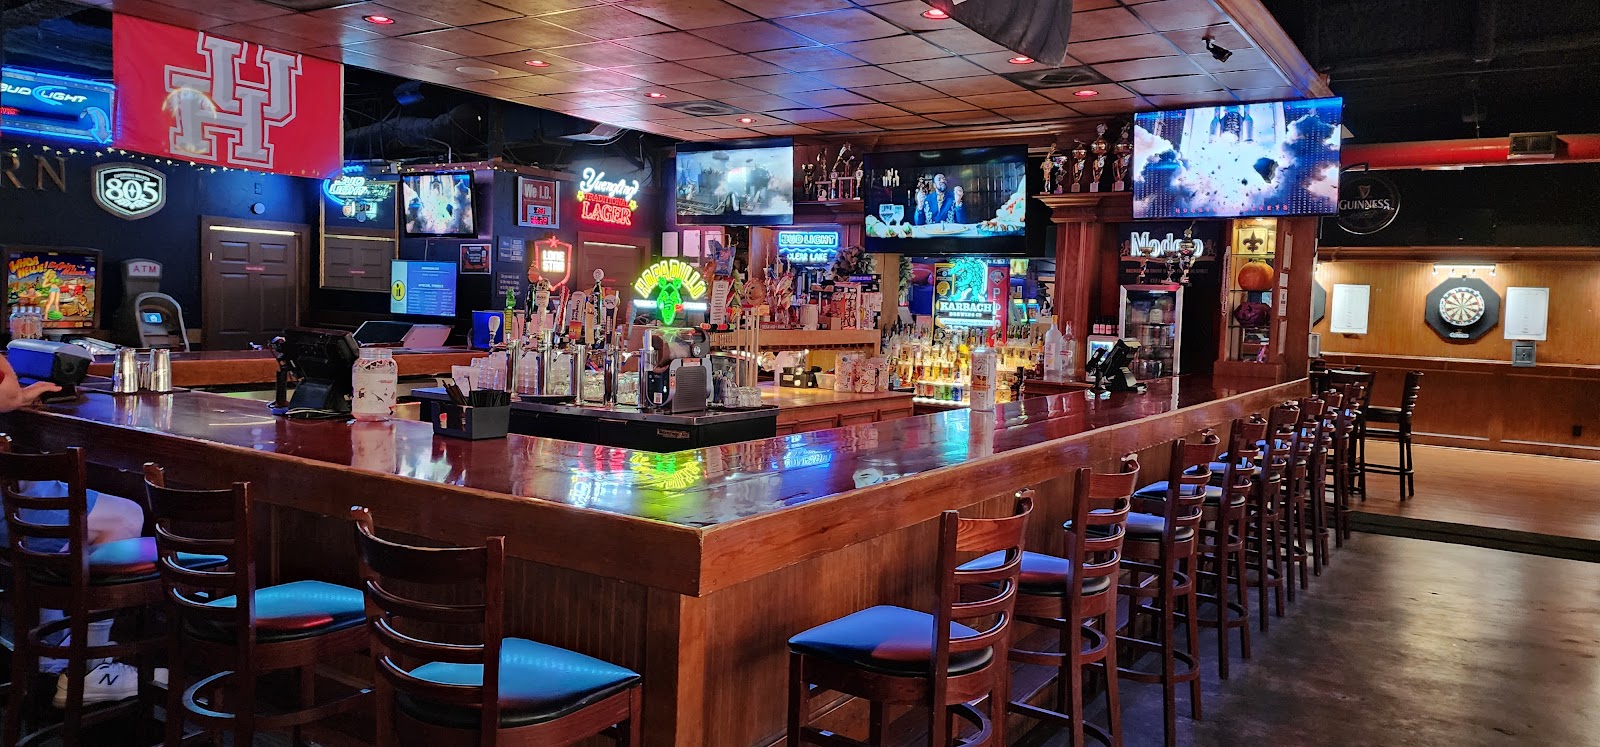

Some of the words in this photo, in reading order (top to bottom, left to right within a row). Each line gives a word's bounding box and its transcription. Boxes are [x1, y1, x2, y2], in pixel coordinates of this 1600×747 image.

[40, 90, 87, 102] LIGHT
[105, 178, 159, 203] 805
[524, 183, 538, 198] We
[580, 167, 639, 200] Yuengling
[584, 193, 629, 207] TRADITIONAL
[1340, 199, 1390, 210] GUINNESS
[581, 201, 632, 225] LAGER
[781, 234, 803, 244] BUD
[804, 234, 835, 245] LIGHT
[9, 256, 40, 273] WHOA
[787, 252, 808, 262] CLEAR
[809, 252, 828, 263] LAKE
[133, 265, 157, 273] ATM
[634, 259, 707, 299] HOPADILLO
[940, 302, 992, 313] KARBACH
